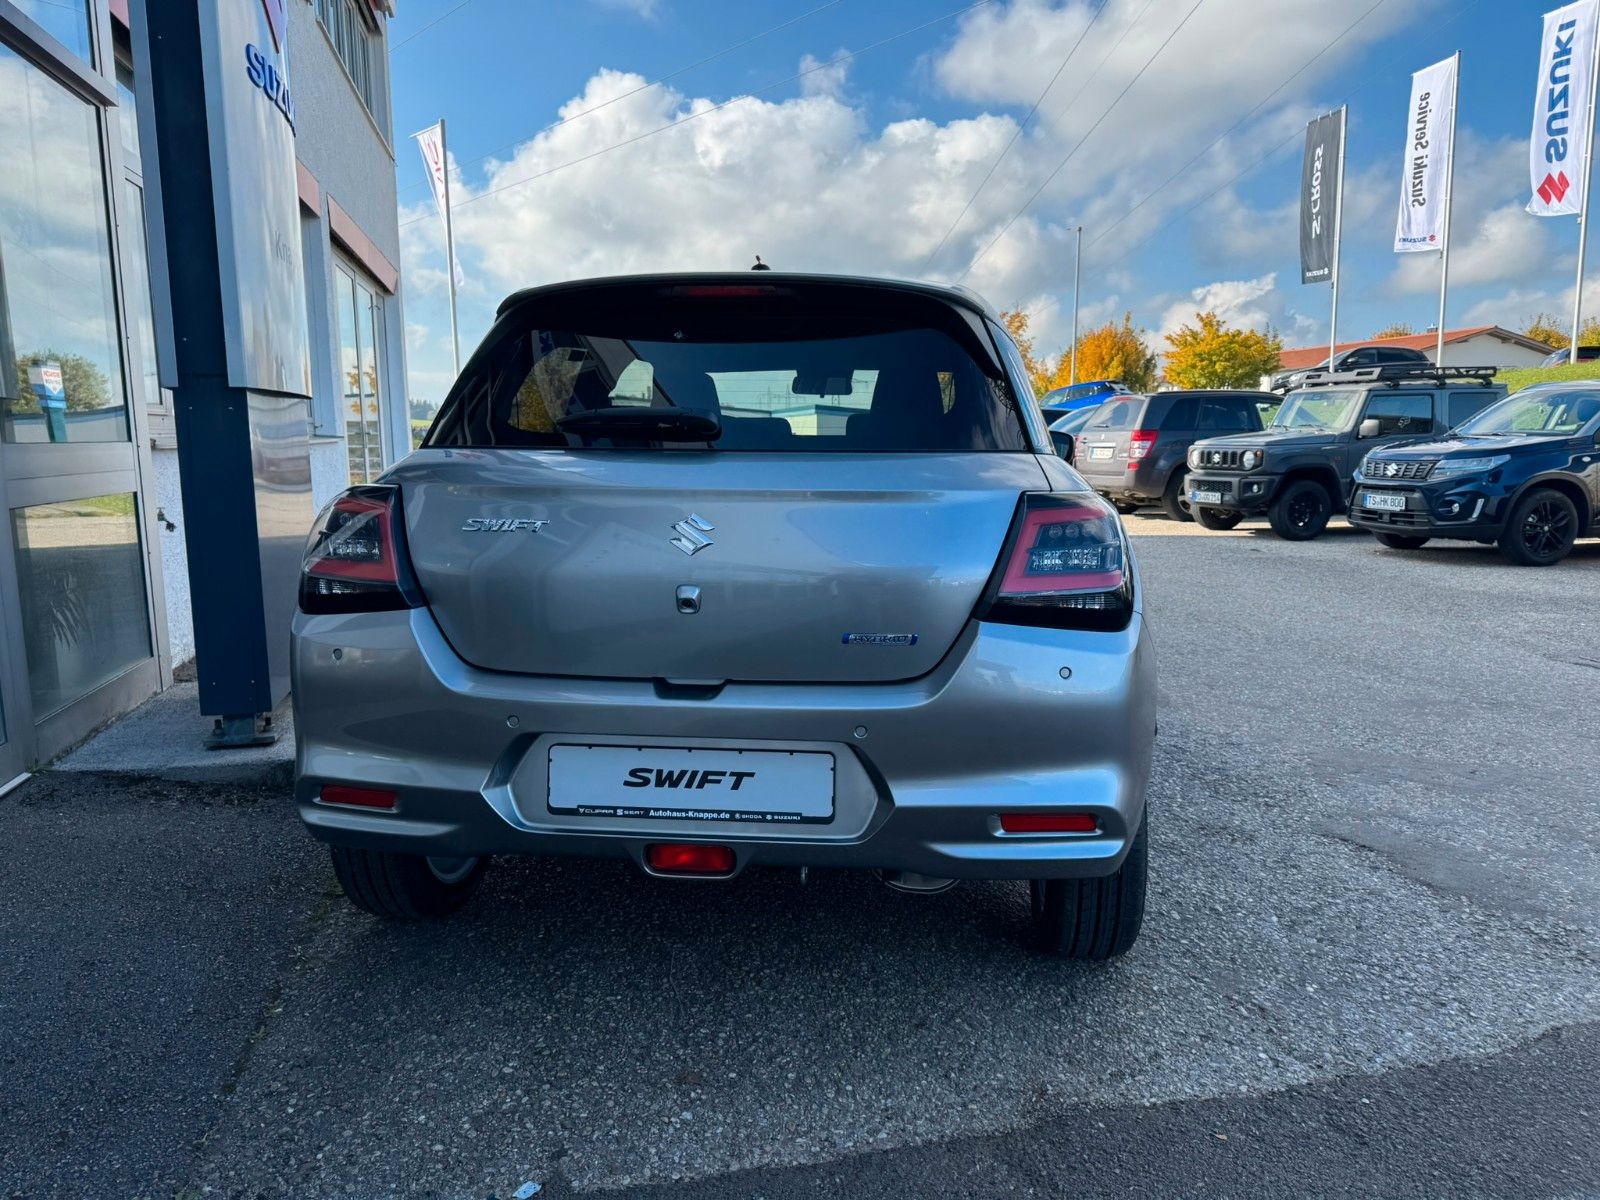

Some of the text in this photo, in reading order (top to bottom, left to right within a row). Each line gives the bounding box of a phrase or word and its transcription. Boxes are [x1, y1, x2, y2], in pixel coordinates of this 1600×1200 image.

[1368, 495, 1377, 506] TS
[462, 518, 551, 533] SWIFT
[623, 767, 756, 791] SWIFT
[649, 809, 730, 820] Autohaus-Knappe.de
